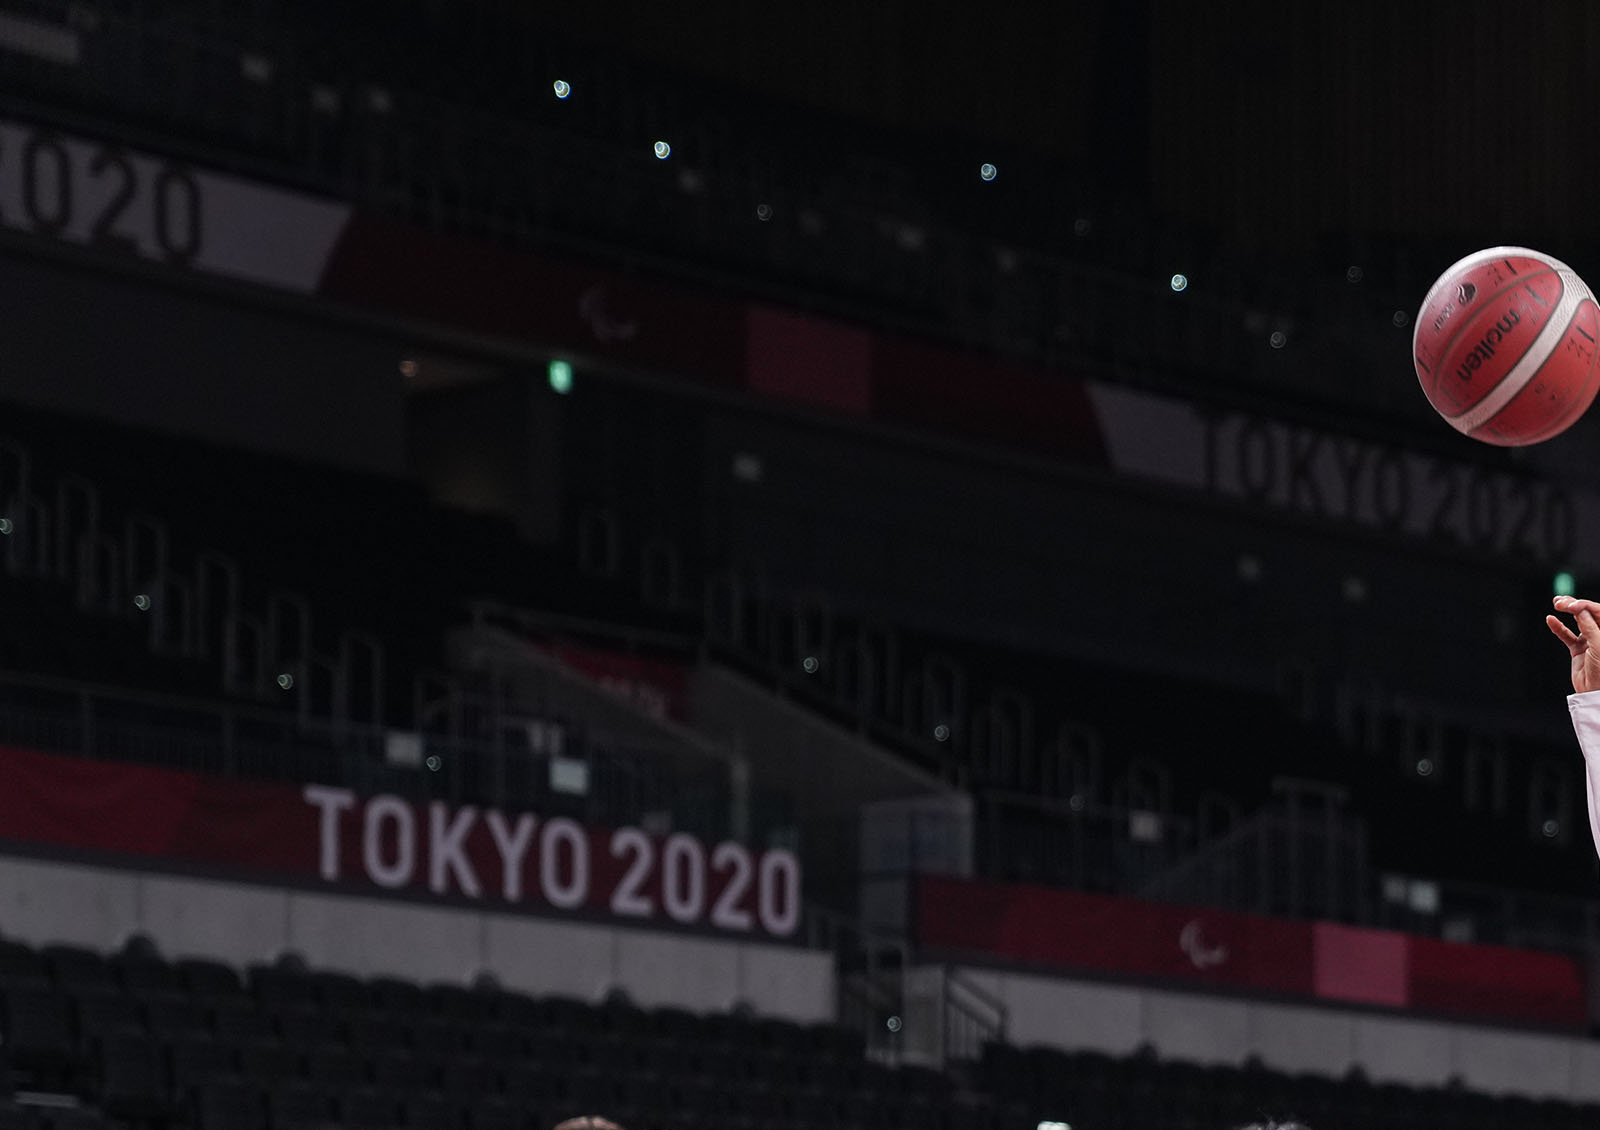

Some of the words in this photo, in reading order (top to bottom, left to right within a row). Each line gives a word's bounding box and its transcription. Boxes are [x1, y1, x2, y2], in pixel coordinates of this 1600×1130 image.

[1456, 308, 1520, 382] molten
[1197, 406, 1404, 530] TOKYO
[1432, 464, 1576, 560] 2020
[302, 783, 591, 909] TOKYO
[608, 825, 802, 936] 2020
